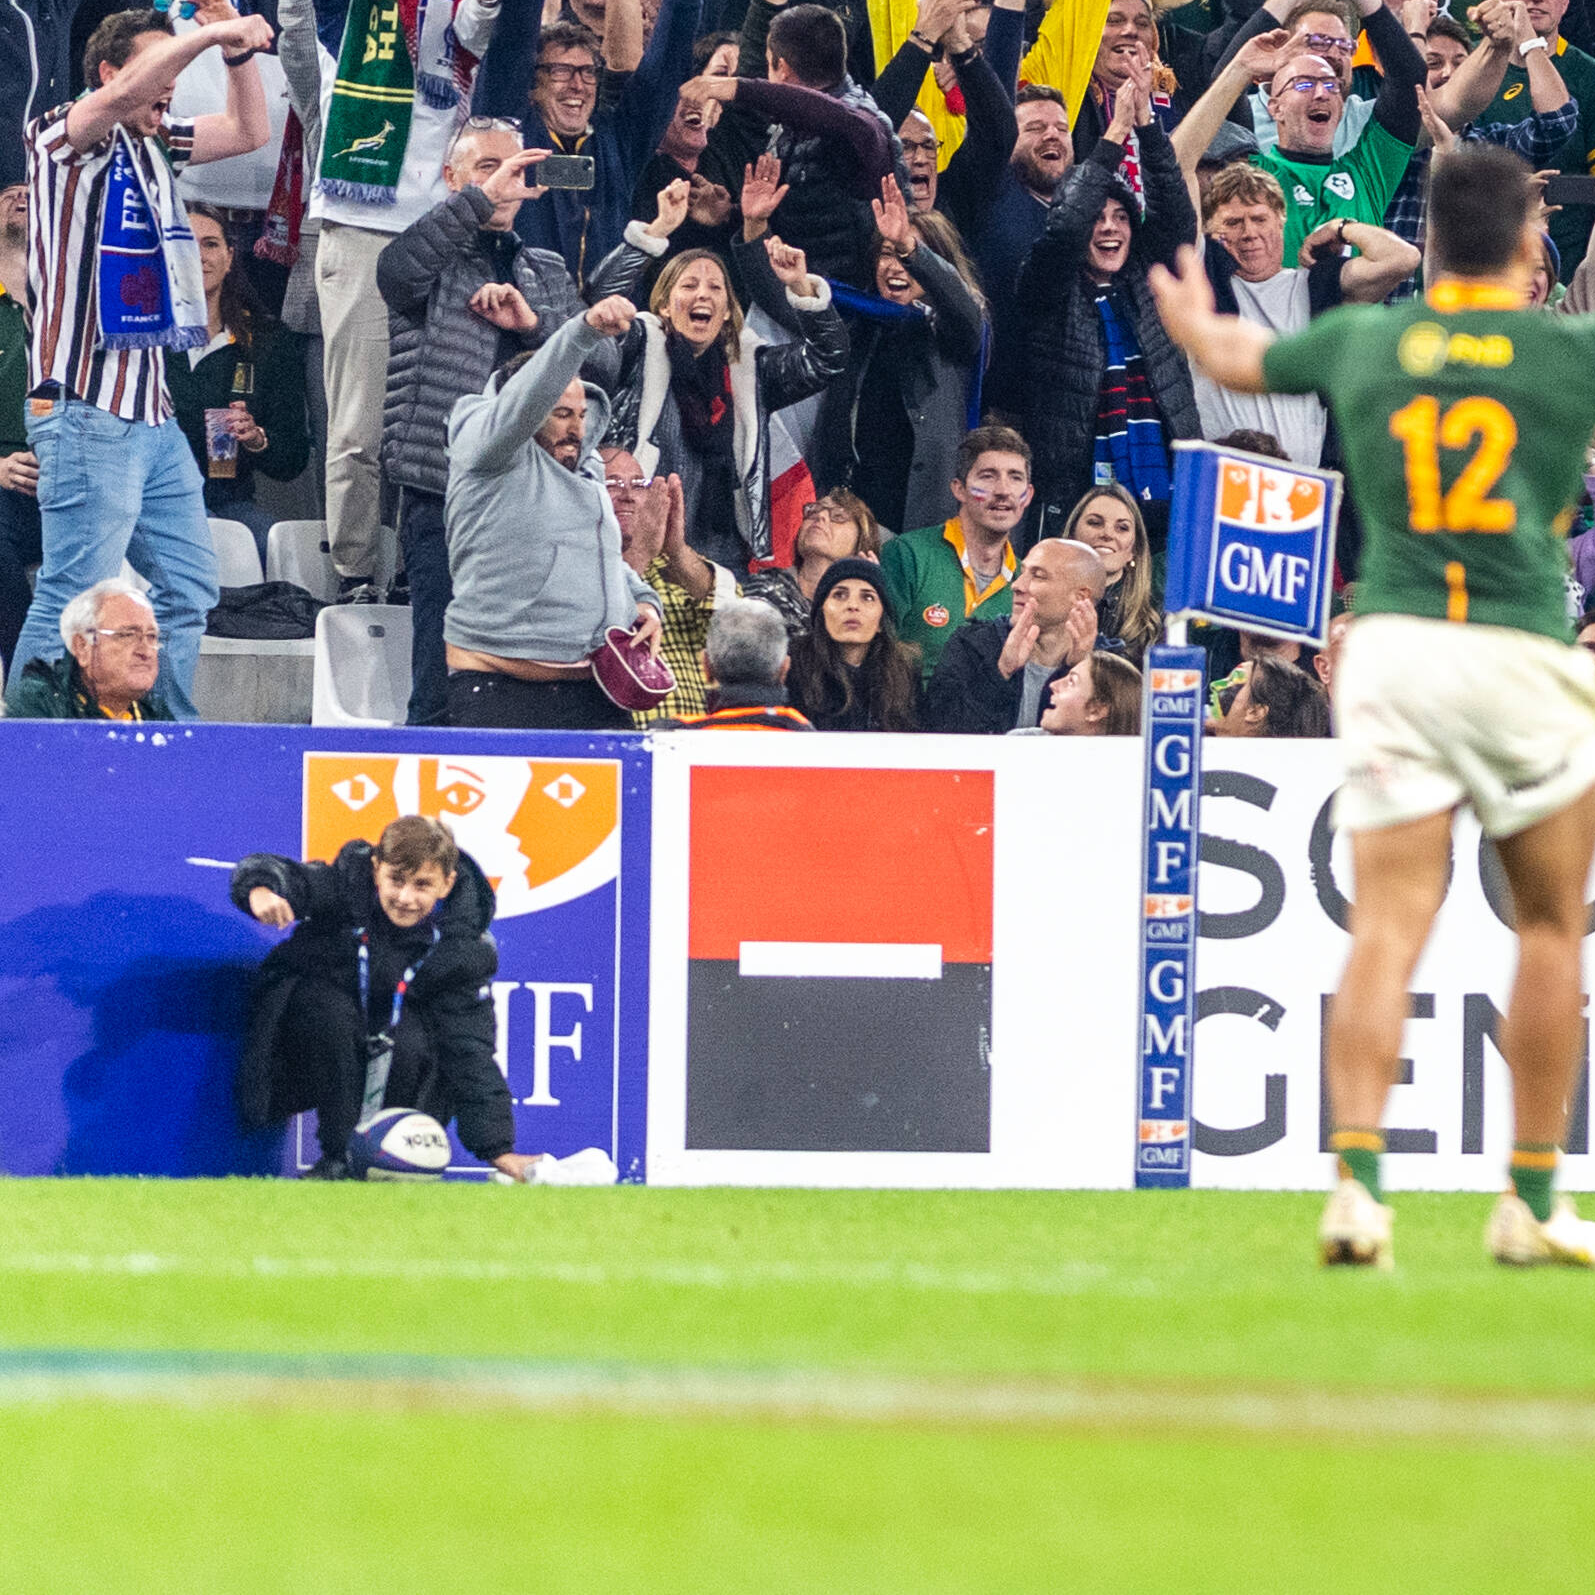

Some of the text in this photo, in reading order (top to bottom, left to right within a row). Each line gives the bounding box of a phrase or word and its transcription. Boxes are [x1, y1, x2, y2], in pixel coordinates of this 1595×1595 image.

[1390, 394, 1518, 534] 12
[1219, 541, 1310, 604] GMF
[1153, 697, 1195, 714] GMF
[1147, 922, 1190, 939] GMF
[1142, 1147, 1186, 1164] GMF
